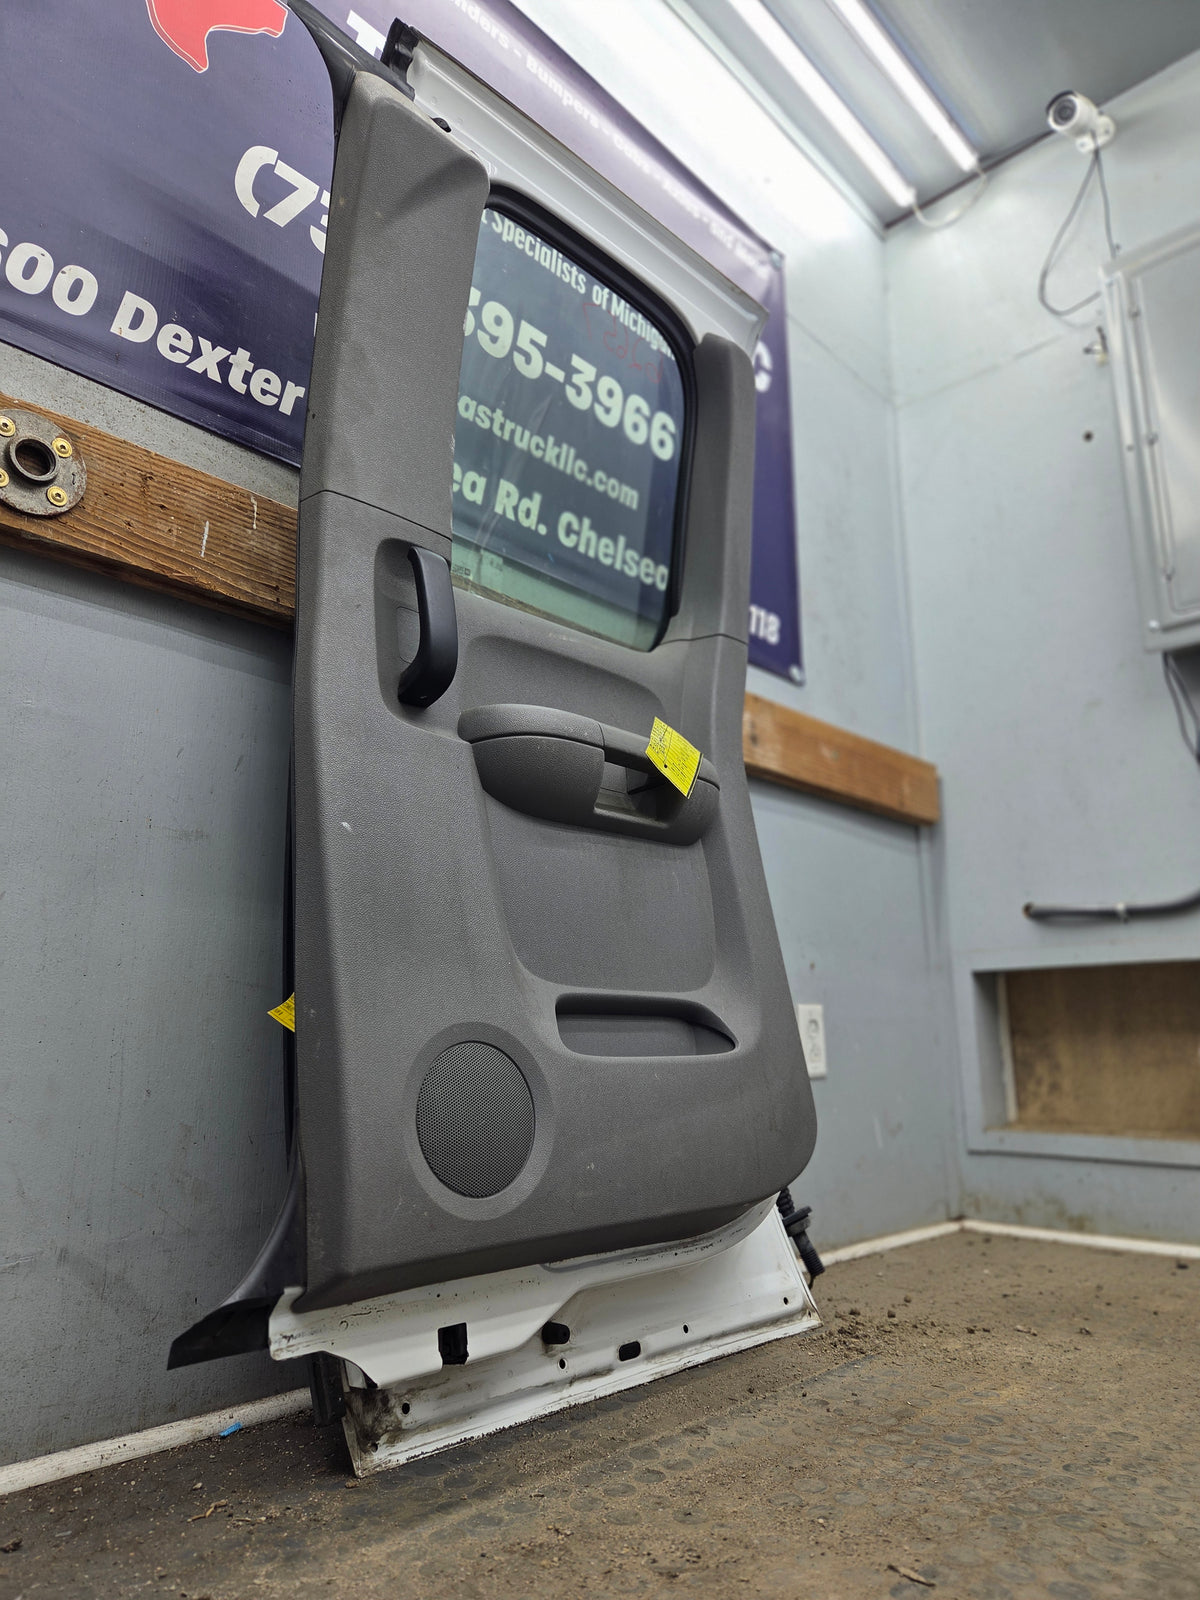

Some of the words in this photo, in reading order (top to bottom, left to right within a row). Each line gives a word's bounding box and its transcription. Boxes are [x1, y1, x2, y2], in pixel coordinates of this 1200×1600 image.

[526, 53, 600, 129] Bumpers
[491, 210, 587, 294] Specialists
[592, 283, 610, 311] of
[0, 228, 98, 316] 00
[110, 290, 305, 416] Dexter
[494, 478, 547, 536] Rd.
[750, 604, 781, 646] 118
